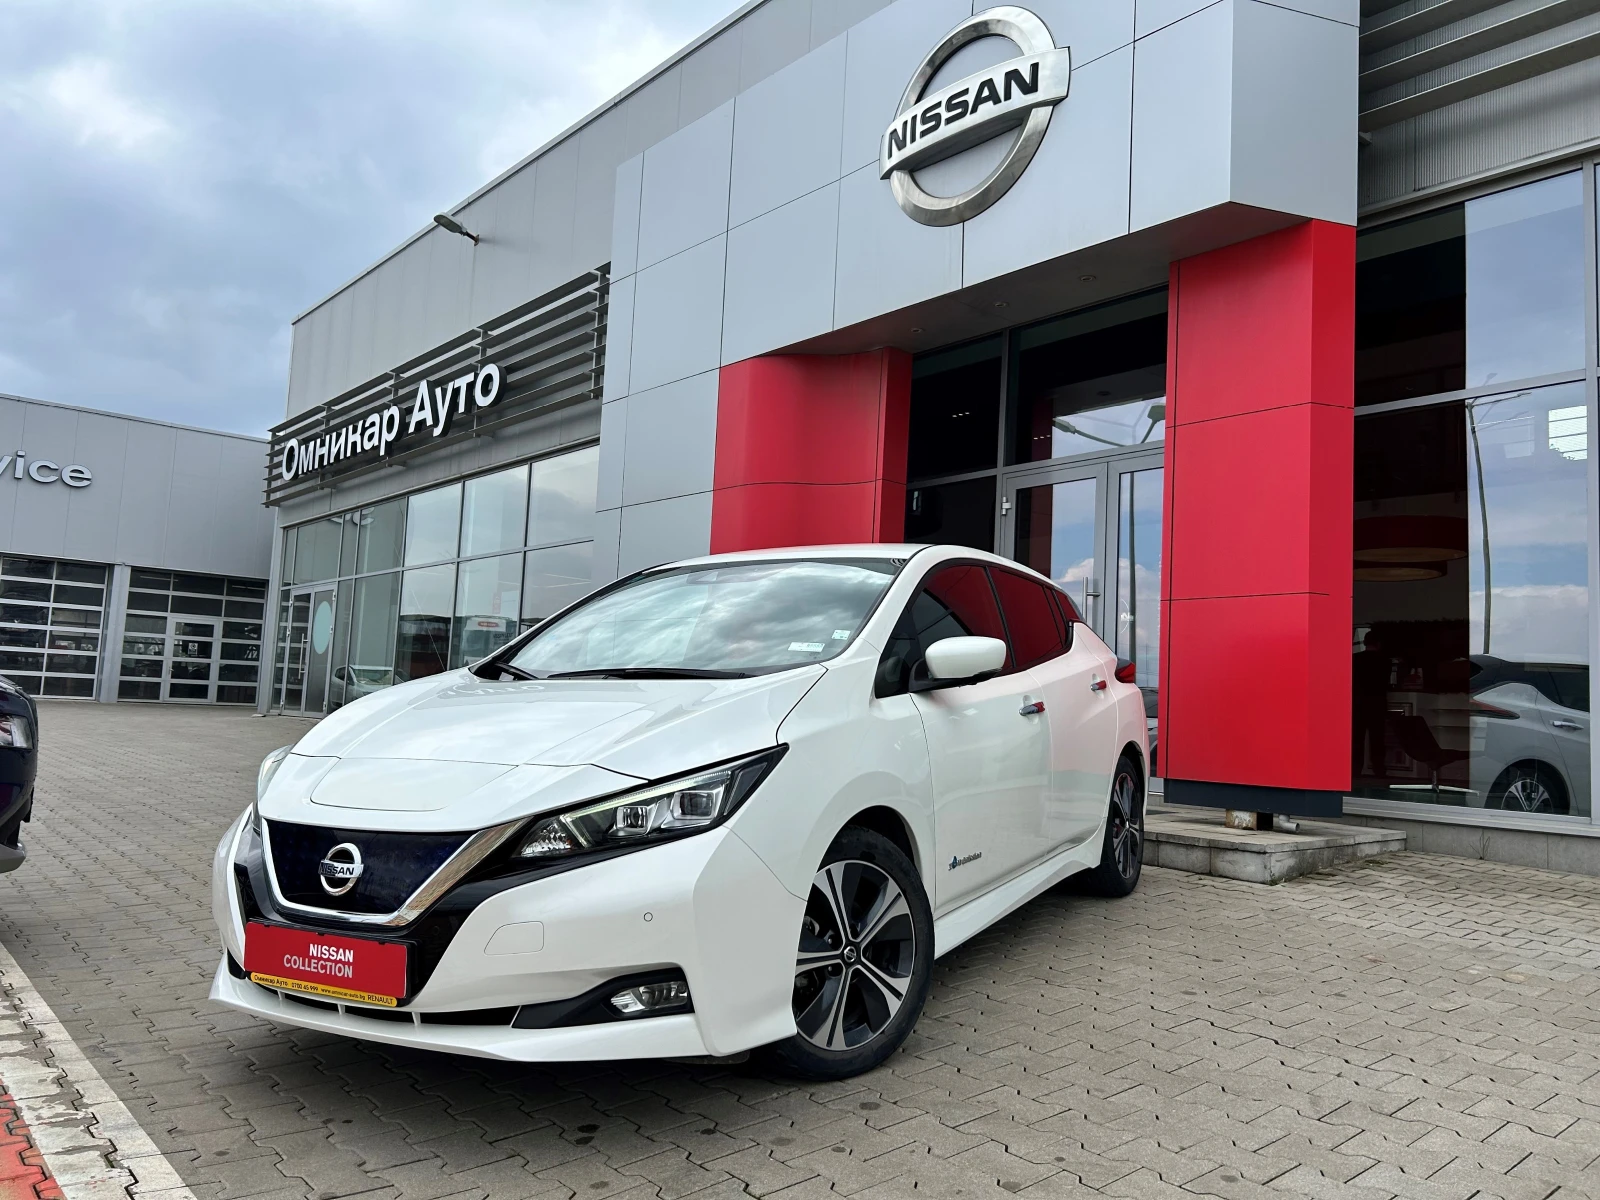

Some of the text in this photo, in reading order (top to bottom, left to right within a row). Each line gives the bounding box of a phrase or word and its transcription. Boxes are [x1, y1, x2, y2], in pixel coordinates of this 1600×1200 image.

[887, 61, 1040, 160] NISSAN
[281, 363, 502, 481] Омникар Ауто
[321, 862, 355, 876] NISSAN
[309, 943, 354, 963] NISSAN
[283, 954, 353, 978] COLLECTION
[367, 994, 394, 1005] RENAULT
